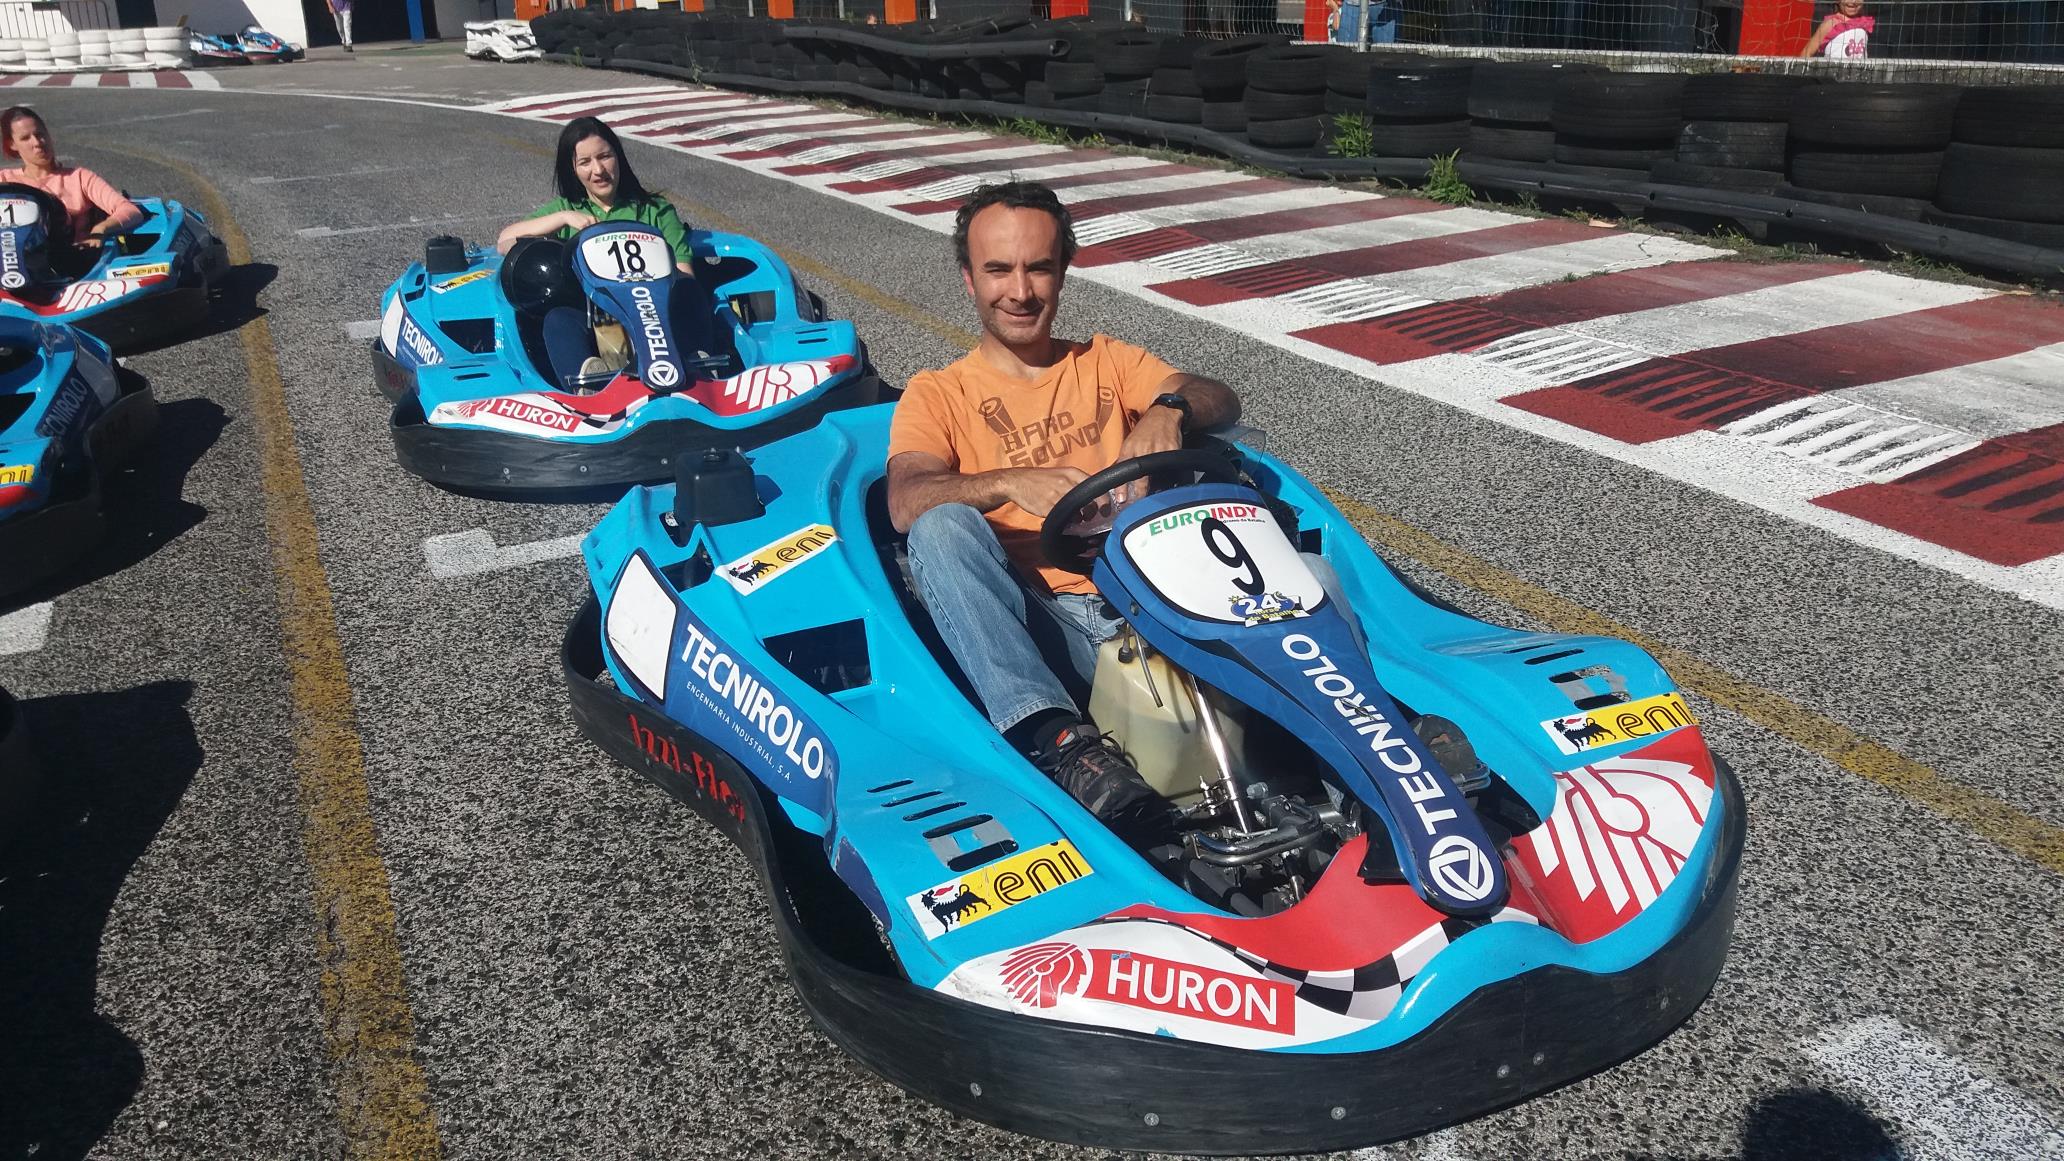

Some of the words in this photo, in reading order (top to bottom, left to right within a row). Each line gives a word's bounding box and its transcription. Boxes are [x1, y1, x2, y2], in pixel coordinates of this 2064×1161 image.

[0, 204, 14, 224] 1
[595, 233, 656, 243] EUROINDY
[608, 240, 646, 273] 18
[631, 286, 670, 360] TECNIROLO
[41, 377, 88, 438] ECNIROLO
[497, 399, 574, 430] HURON
[1000, 411, 1075, 454] HARD
[1009, 421, 1101, 468] SOUND
[1149, 506, 1257, 536] EUROINDY
[776, 528, 834, 563] eni
[1201, 517, 1266, 595] 9
[1239, 594, 1282, 616] 24
[681, 623, 824, 779] TECNIROLO
[1615, 692, 1697, 739] eni
[686, 681, 730, 725] ENGENHARIA
[731, 721, 776, 769] INDUSTRIAL,
[777, 764, 792, 784] S.A.
[1281, 633, 1458, 836] TECNIROLO
[992, 839, 1083, 906] eni
[1107, 952, 1278, 1026] HURON
